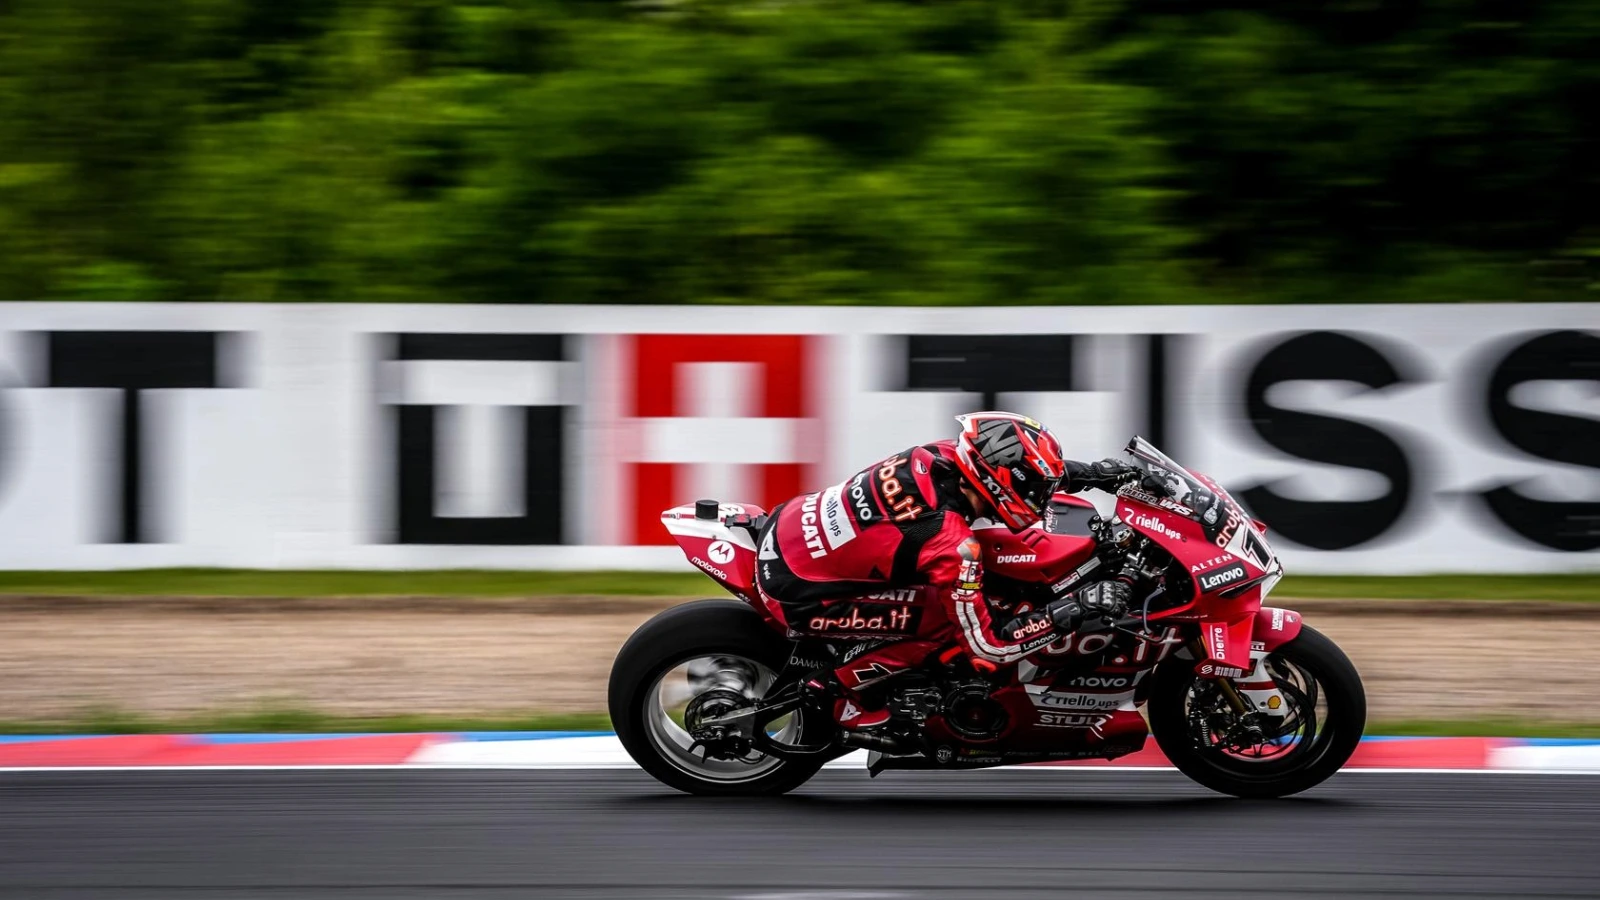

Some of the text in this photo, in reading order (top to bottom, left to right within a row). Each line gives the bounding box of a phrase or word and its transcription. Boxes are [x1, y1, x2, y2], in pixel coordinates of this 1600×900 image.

[1160, 499, 1194, 516] WRS
[801, 491, 828, 559] DUCATI
[829, 519, 842, 538] ups
[1136, 514, 1182, 540] riello ups
[691, 556, 728, 580] motorola
[997, 554, 1037, 564] DUCATI
[1191, 554, 1233, 573] ALTEN
[1201, 567, 1244, 589] Lenovo
[809, 606, 911, 630] aruba.it
[1023, 632, 1057, 649] Lenovo
[1055, 694, 1096, 707] riello
